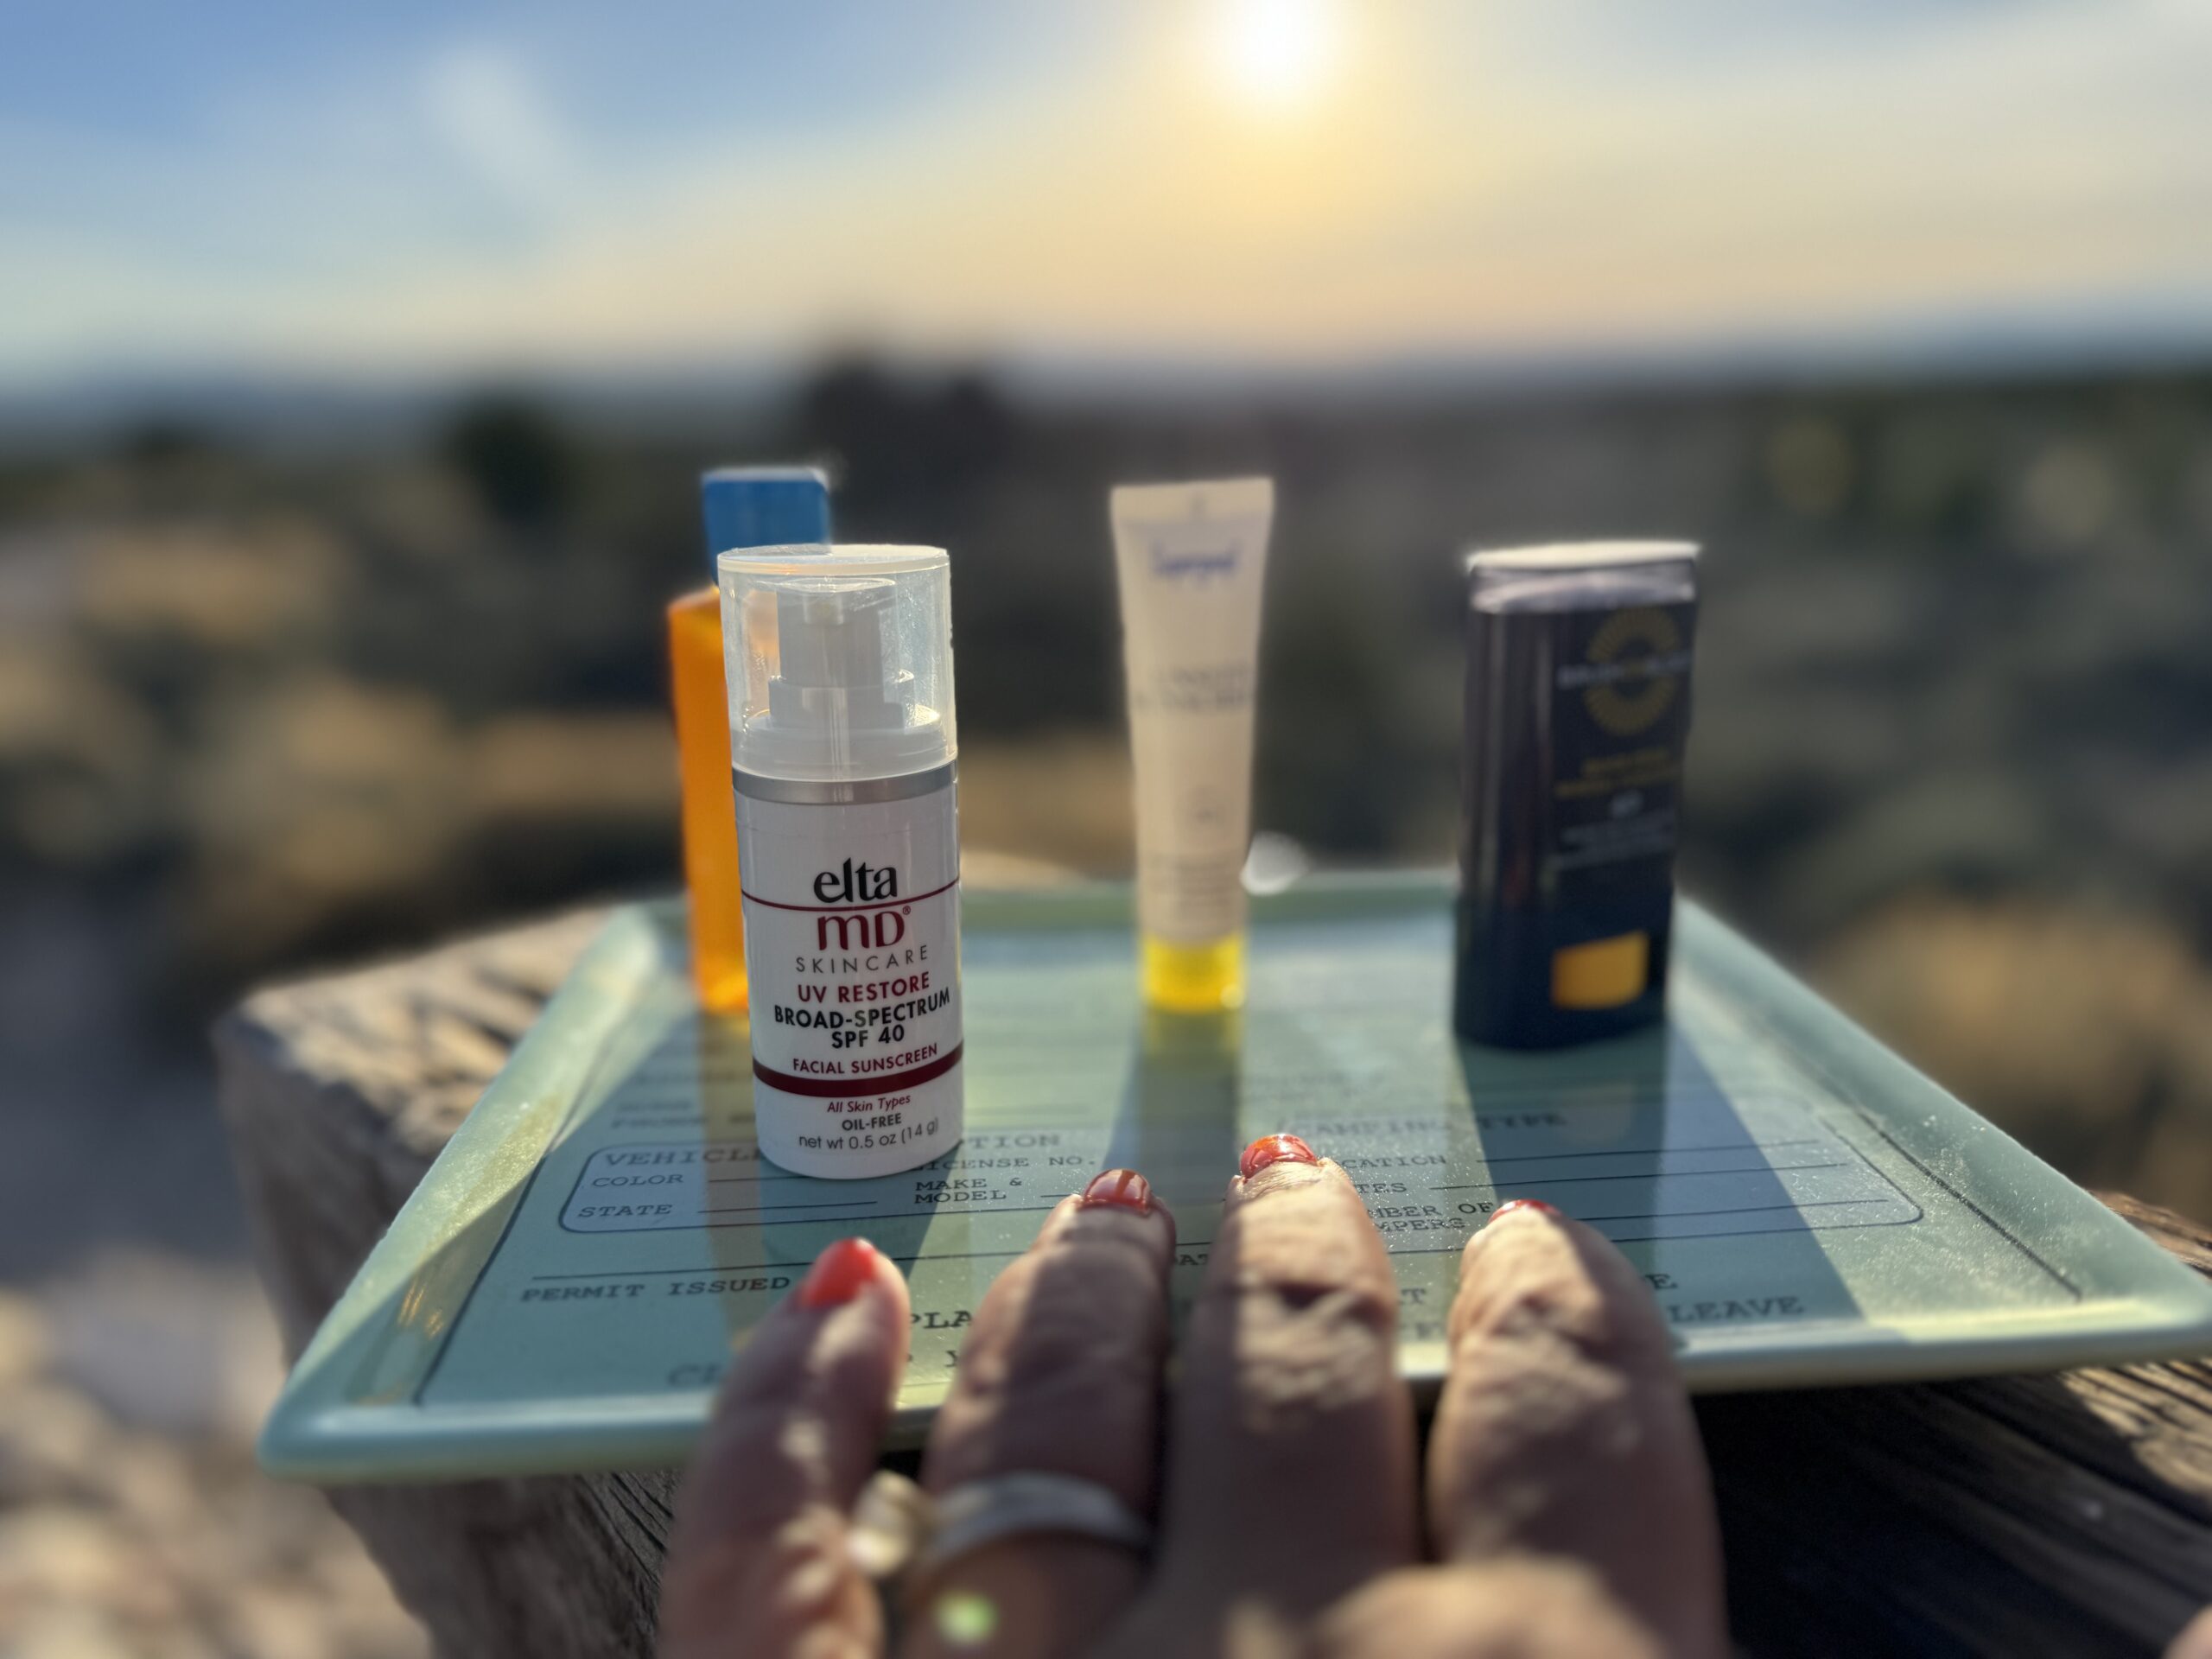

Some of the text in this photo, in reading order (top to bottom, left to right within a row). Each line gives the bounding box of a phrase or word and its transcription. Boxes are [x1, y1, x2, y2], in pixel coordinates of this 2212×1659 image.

[814, 857, 898, 903] elta
[796, 944, 928, 974] SKINCARE
[798, 971, 930, 1003] UV RESTORE
[774, 988, 950, 1029] BROAD-SPECTRUM
[831, 1024, 905, 1049] SPF 40
[792, 1043, 938, 1074] FACIAL SUNSCREEN
[827, 1095, 911, 1113] All Skin Types
[842, 1113, 902, 1131] OIL-FREE
[798, 1118, 939, 1149] net wt 0.5 oz (14 g)
[1048, 1156, 1096, 1166] NO.
[1335, 1155, 1446, 1168] CATION
[593, 1173, 683, 1188] COLOR
[915, 1177, 1022, 1192] MAKE &
[914, 1189, 1007, 1204] MODEL
[577, 1204, 673, 1218] STATE
[1458, 1202, 1493, 1215] OF
[521, 1276, 791, 1302] PERMIT ISSUED
[1669, 1296, 1804, 1323] LEAVE
